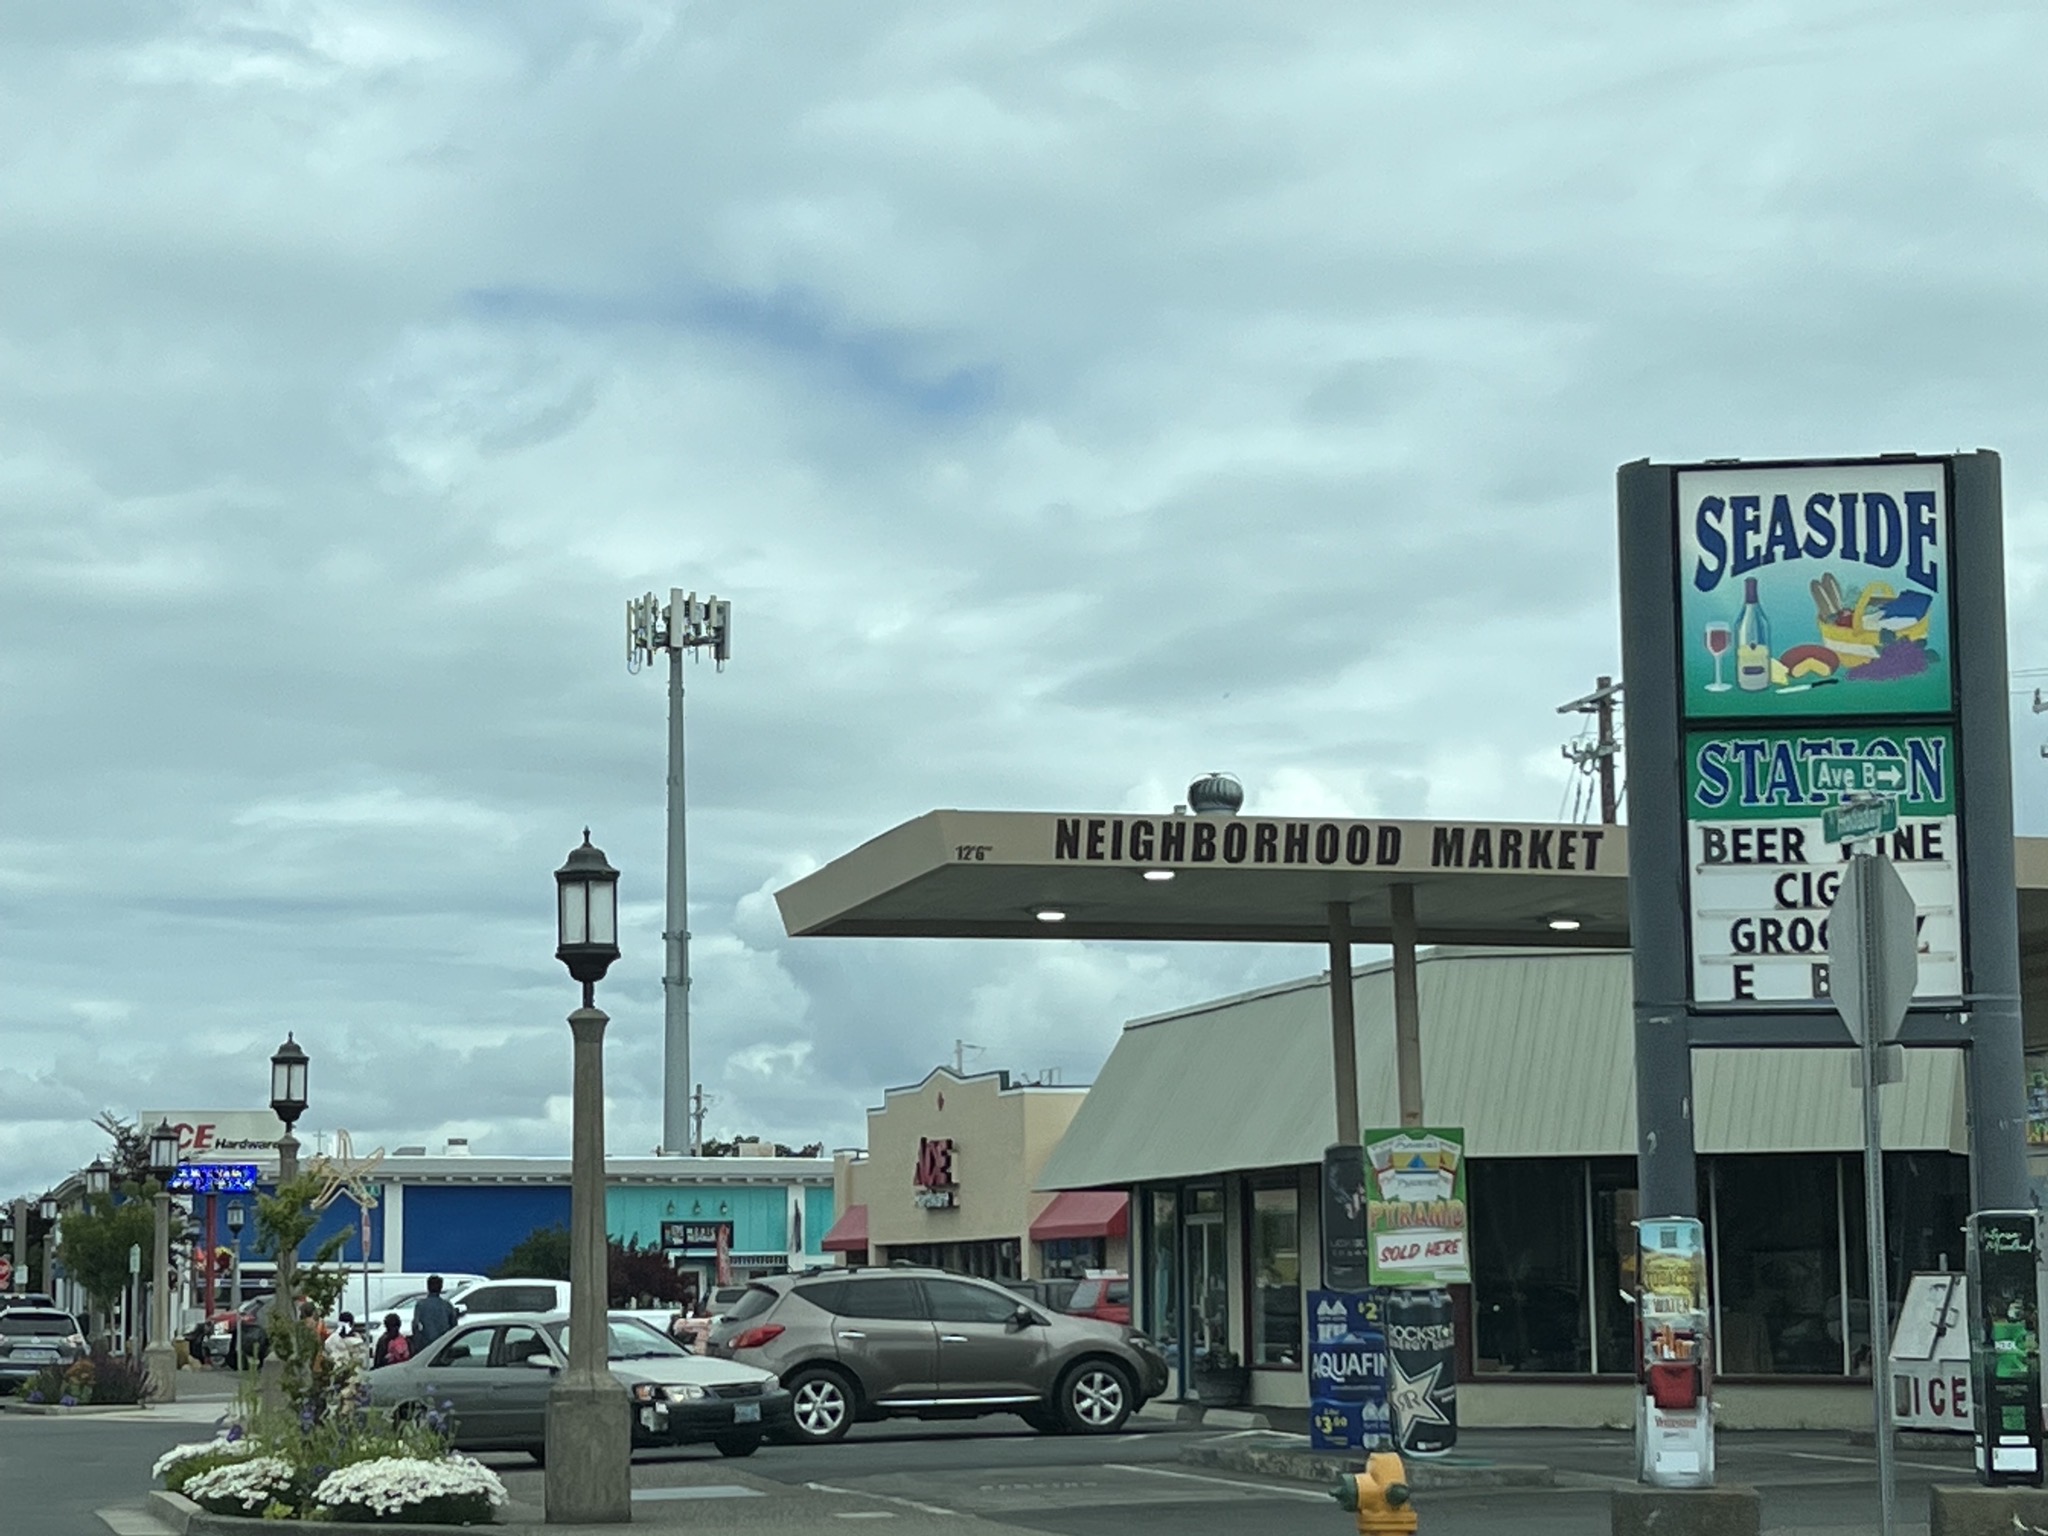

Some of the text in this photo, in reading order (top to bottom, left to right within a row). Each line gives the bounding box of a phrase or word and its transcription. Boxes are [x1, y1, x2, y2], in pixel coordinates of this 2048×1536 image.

[1694, 490, 1938, 594] SEASIDE
[1696, 737, 1945, 807] STAN
[1817, 761, 1876, 788] Ave B
[1055, 817, 1604, 872] NEIGHBORHOOD MARKET
[1703, 826, 1807, 863] BEER
[1369, 1201, 1465, 1229] PYRAMID
[1380, 1243, 1421, 1263] SOLD
[1425, 1239, 1462, 1258] HERE
[1913, 1376, 1968, 1418] ICE
